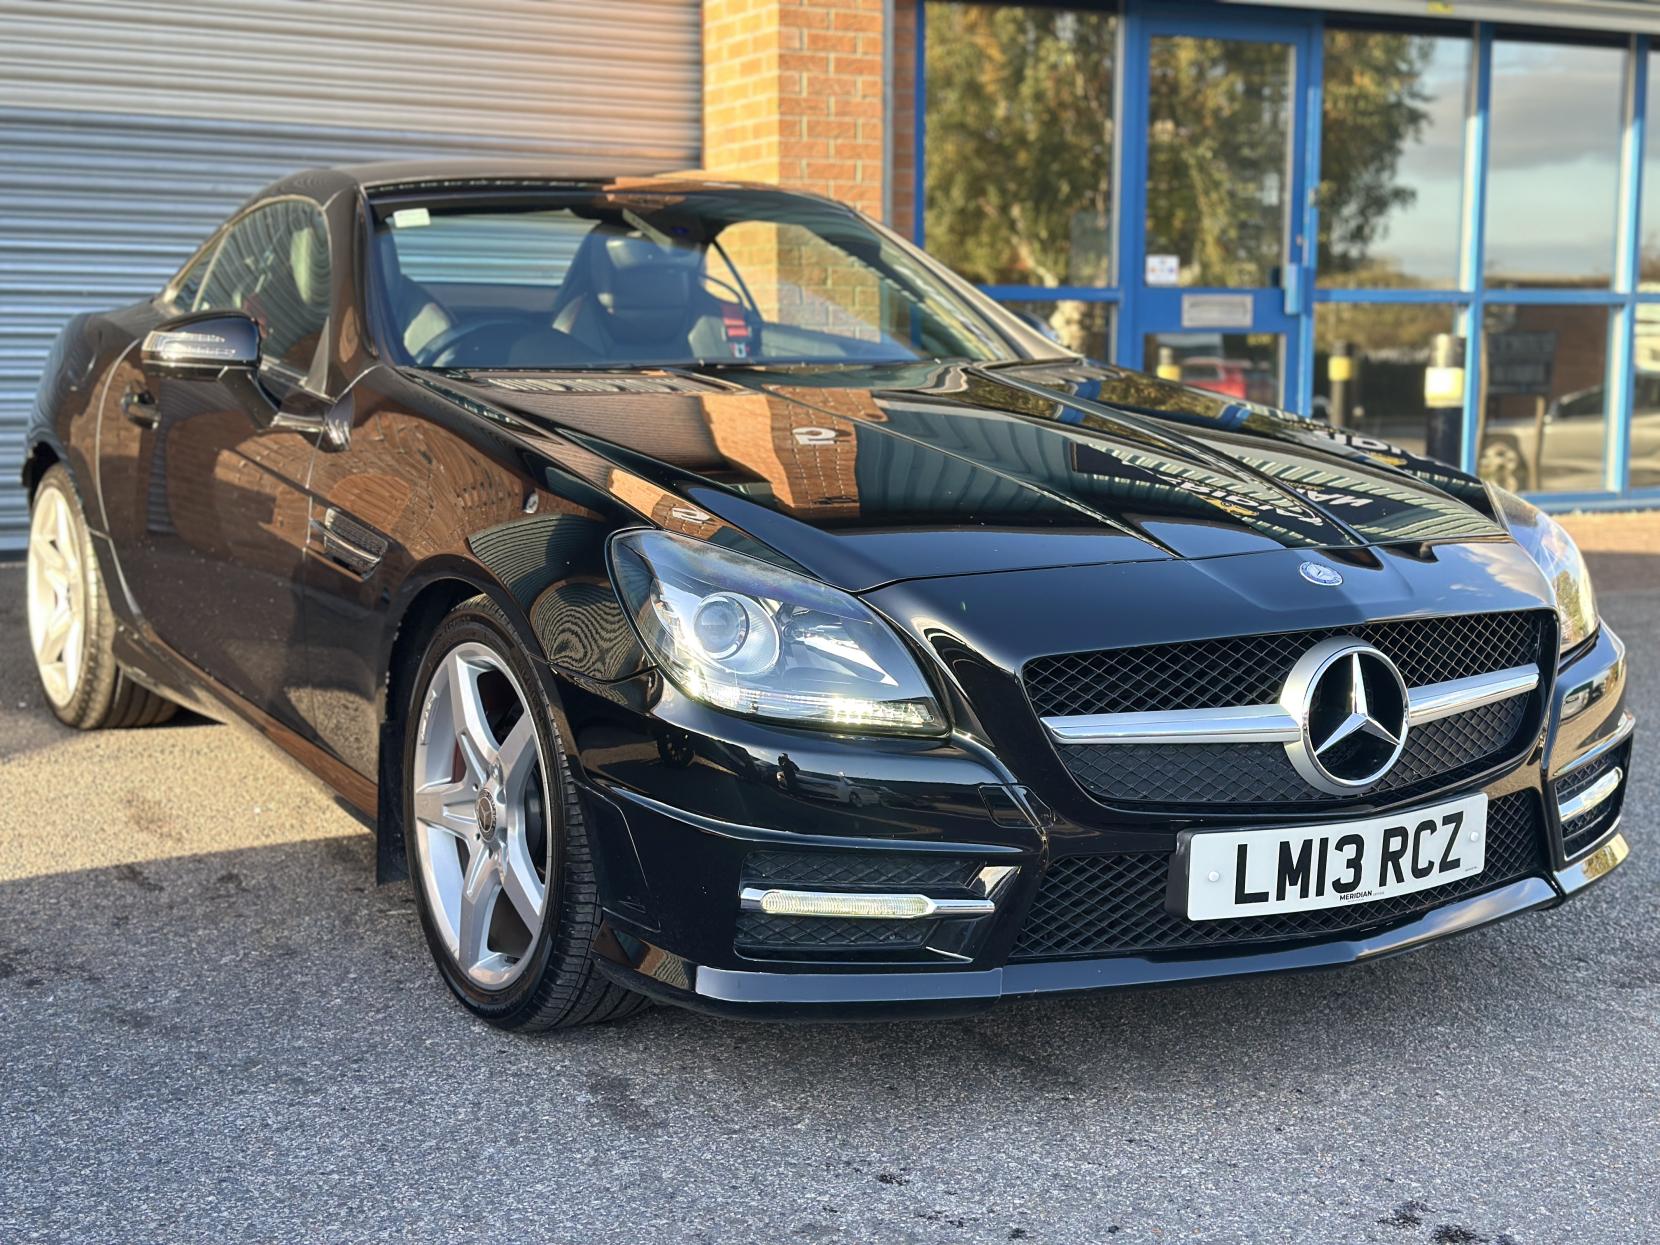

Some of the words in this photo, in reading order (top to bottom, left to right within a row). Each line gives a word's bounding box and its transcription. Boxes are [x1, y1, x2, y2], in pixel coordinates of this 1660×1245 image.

[1234, 833, 1365, 905] LM13
[1378, 811, 1464, 888] RCZ
[1339, 890, 1373, 901] MERIDIAN
